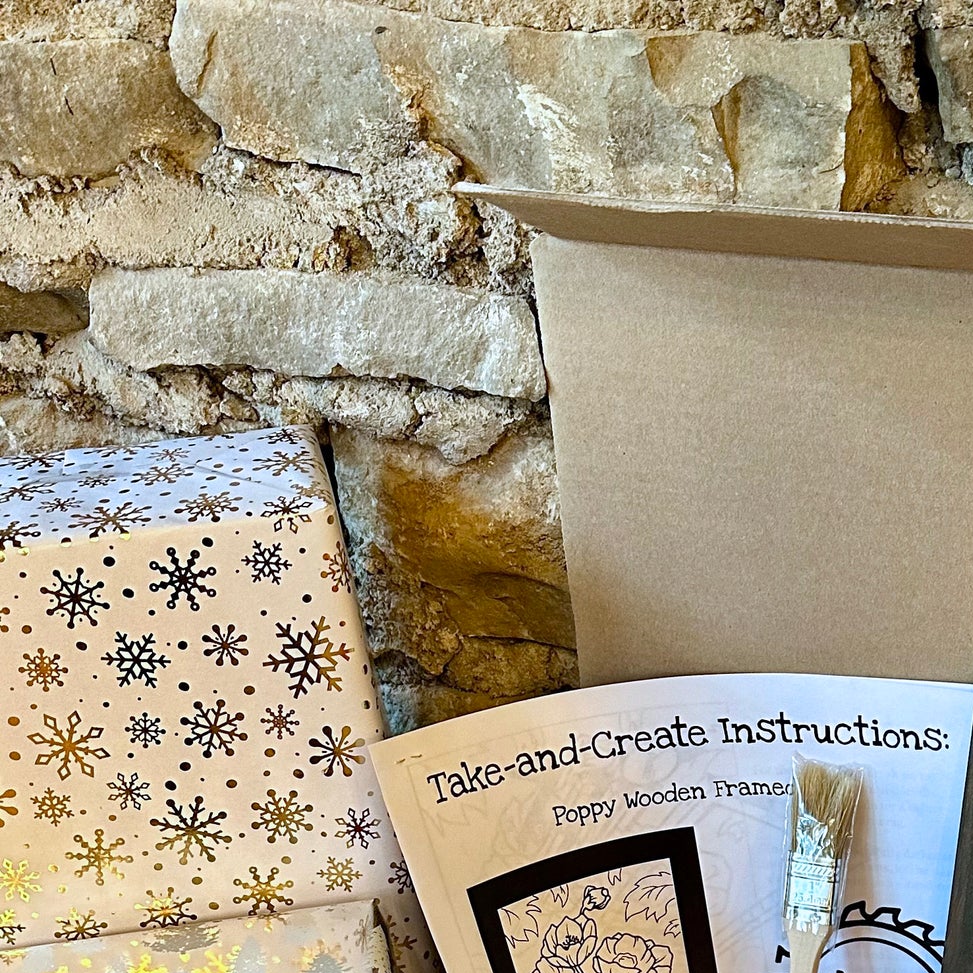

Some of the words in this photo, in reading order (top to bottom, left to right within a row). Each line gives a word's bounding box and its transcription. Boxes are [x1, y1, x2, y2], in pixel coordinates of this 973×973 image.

[426, 715, 709, 804] Take-and-Create
[716, 711, 950, 751] Instructions:
[552, 799, 616, 827] Poppy
[623, 782, 706, 809] Wooden
